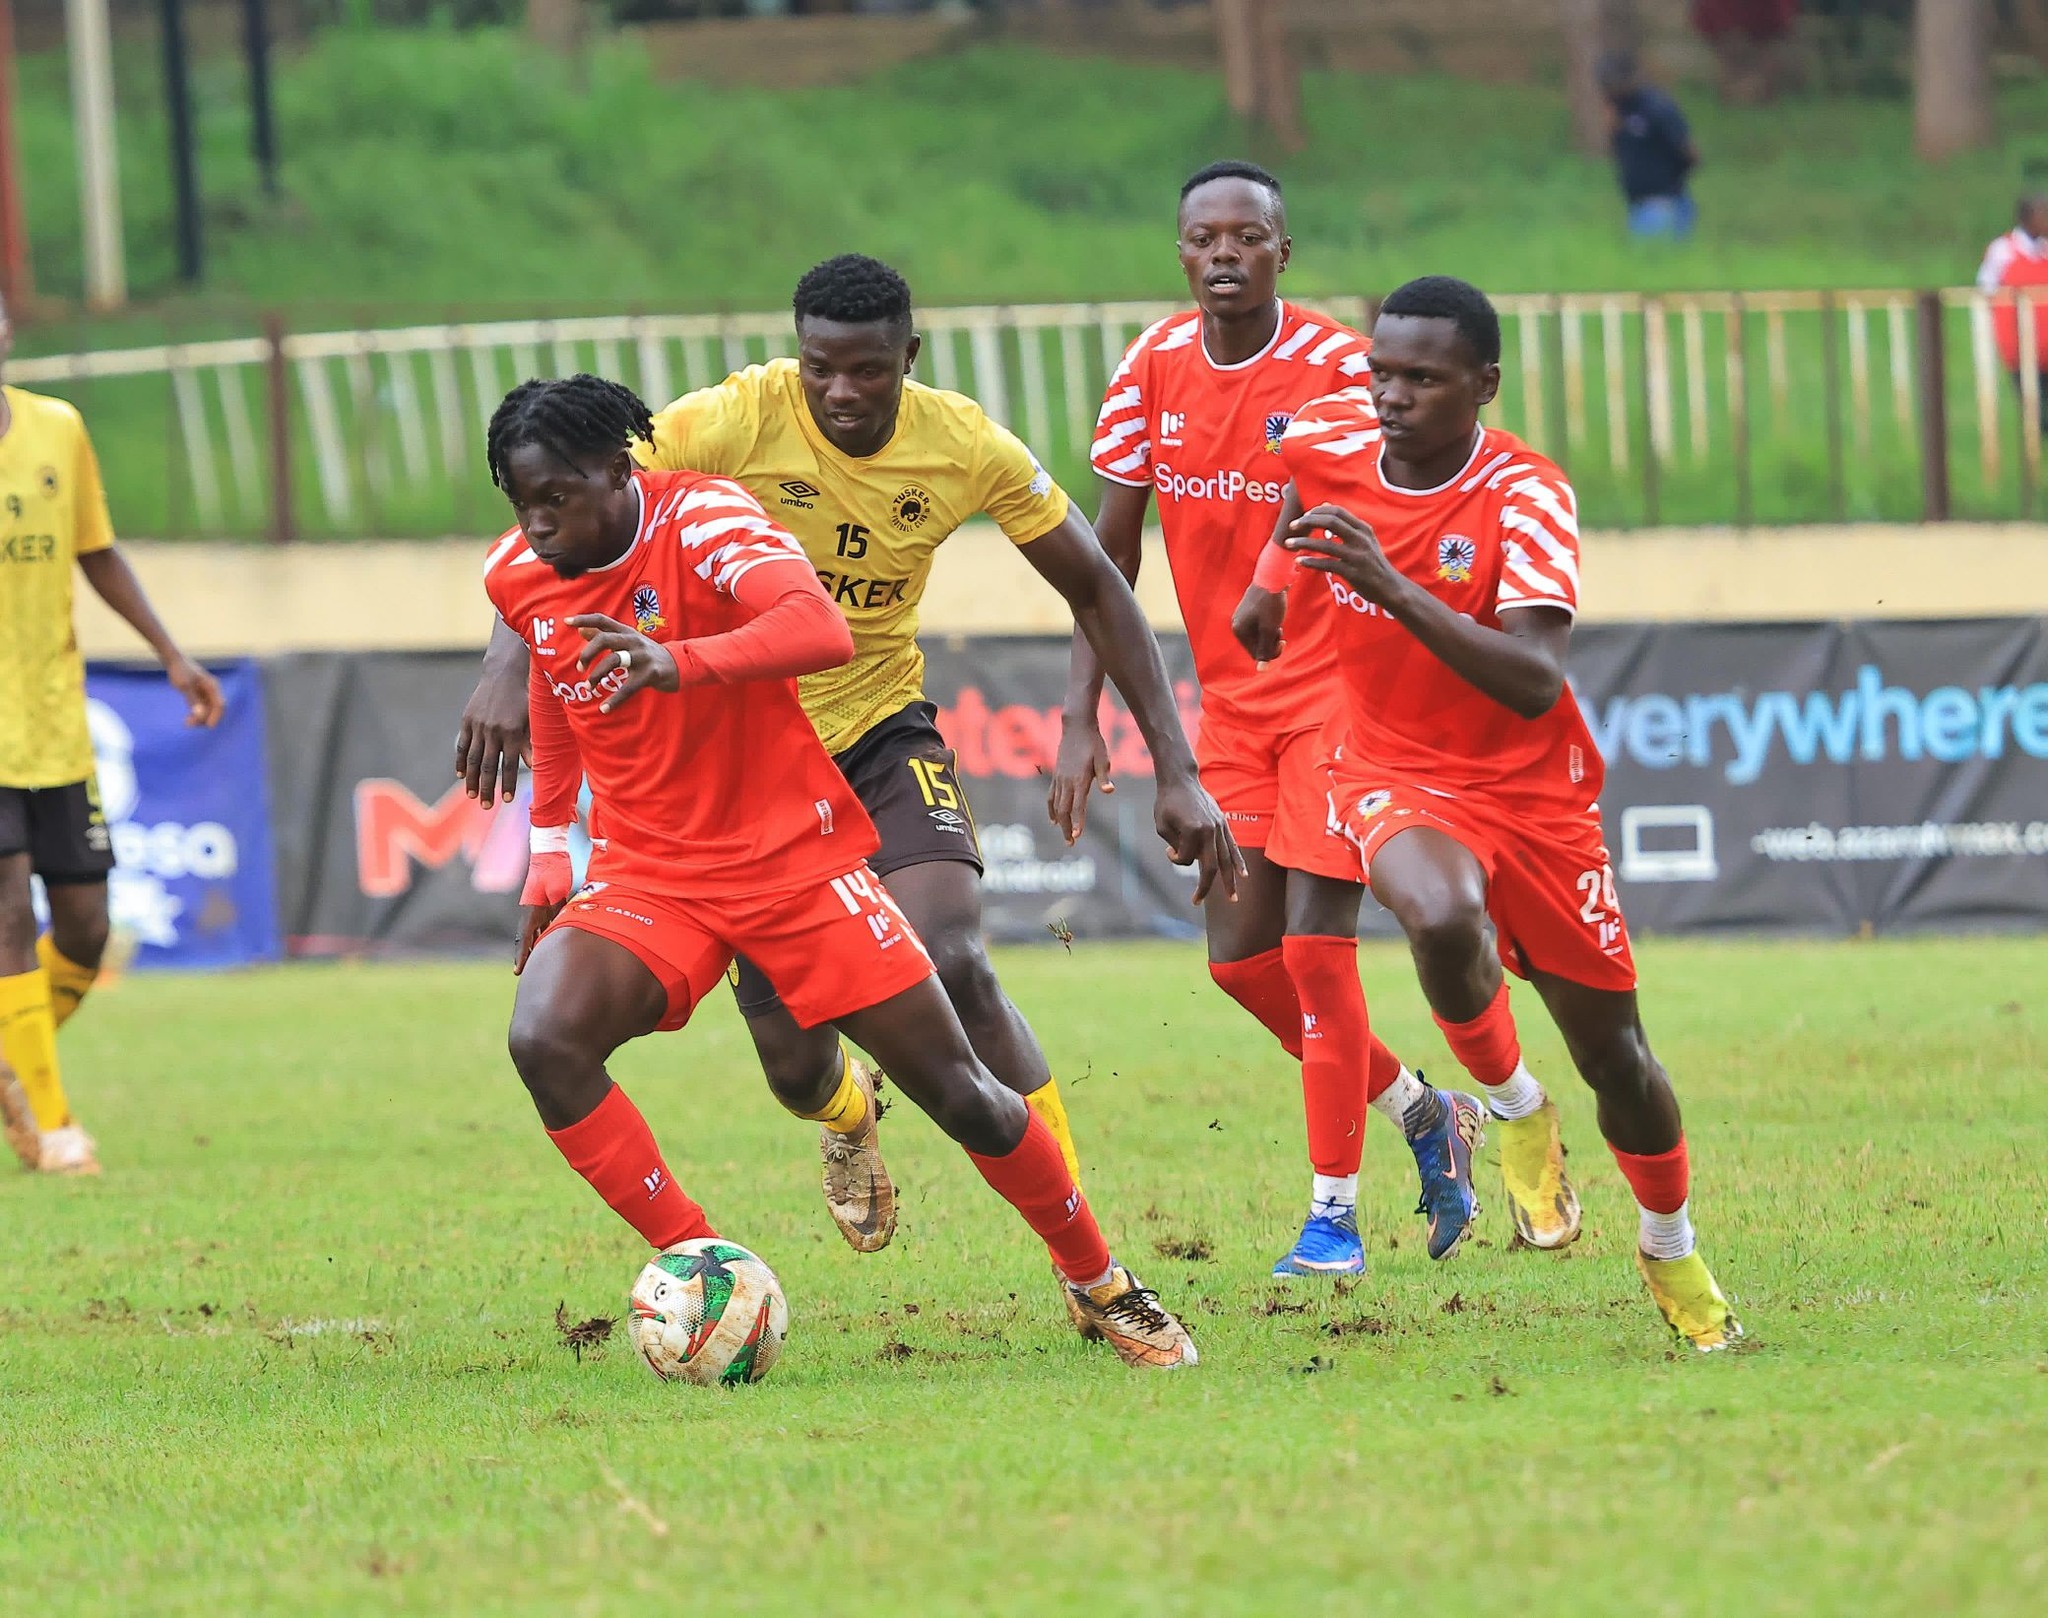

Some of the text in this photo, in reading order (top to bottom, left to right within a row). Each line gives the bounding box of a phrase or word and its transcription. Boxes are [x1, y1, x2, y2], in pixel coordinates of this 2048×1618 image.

[780, 497, 814, 510] umbro
[893, 488, 930, 505] TUSKER
[0, 534, 55, 563] KER
[836, 522, 870, 559] 15
[816, 571, 910, 609] SKER
[1570, 664, 2048, 786] verywhere
[907, 757, 959, 811] 15
[935, 823, 965, 835] umbro
[1224, 811, 1259, 822] ASINO
[829, 869, 879, 916] 14
[605, 906, 654, 926] CASINO
